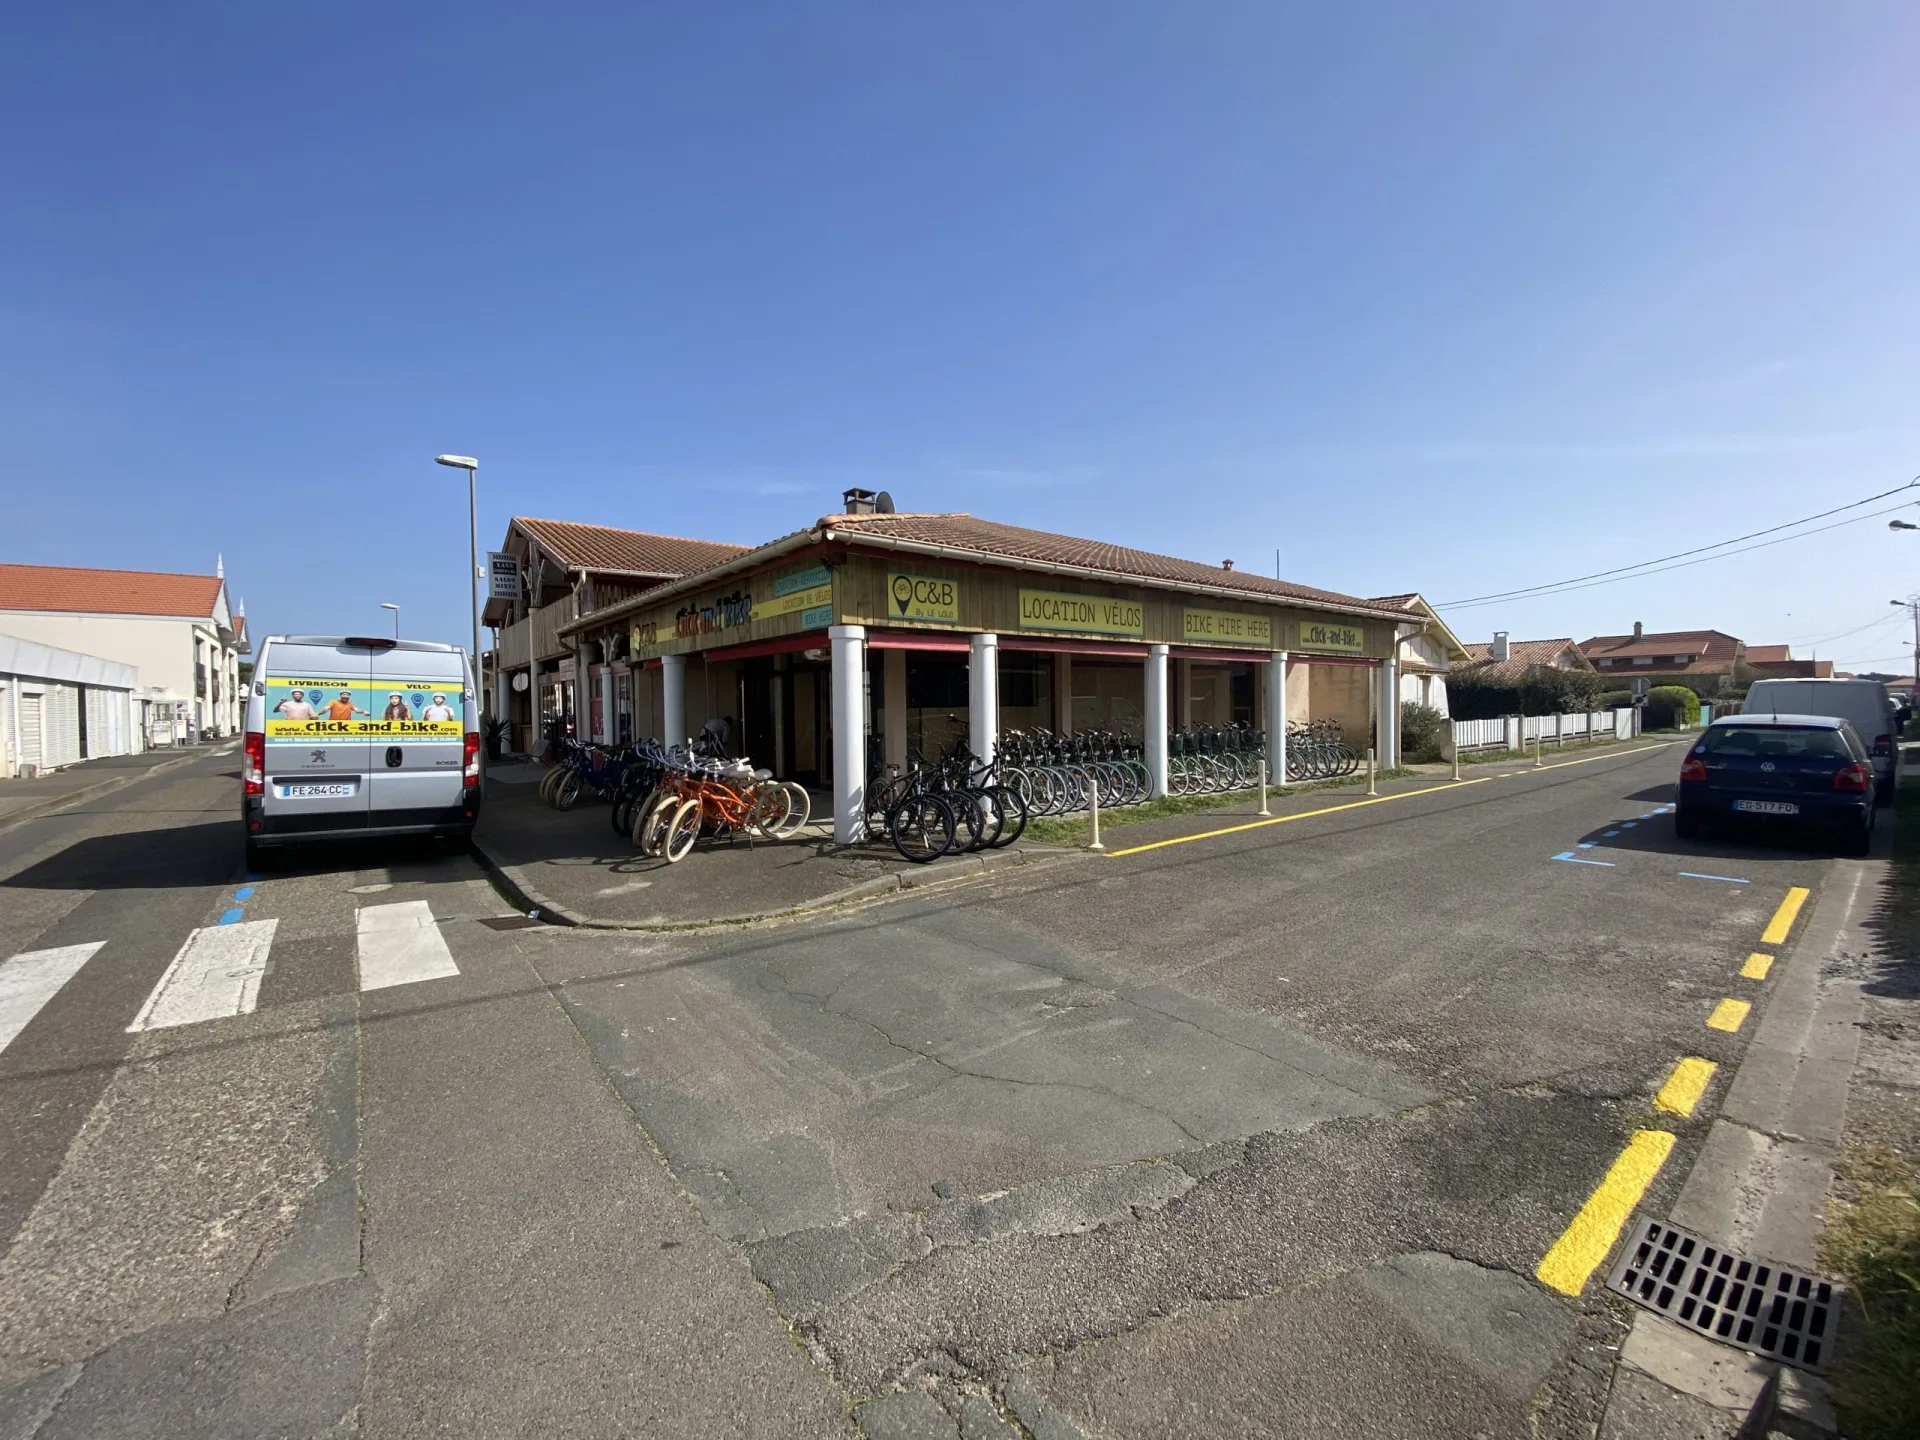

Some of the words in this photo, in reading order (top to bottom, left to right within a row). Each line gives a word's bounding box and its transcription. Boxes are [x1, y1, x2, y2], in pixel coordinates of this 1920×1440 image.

[783, 596, 805, 610] LOCATION
[806, 593, 813, 605] DE
[914, 580, 954, 606] C&B
[1023, 596, 1096, 623] LOCATION
[1103, 602, 1141, 627] VÉLOS
[1186, 614, 1212, 634] BIKE
[1218, 617, 1242, 636] HIRE
[1247, 619, 1269, 638] HERE
[292, 785, 343, 796] FE-264-CC
